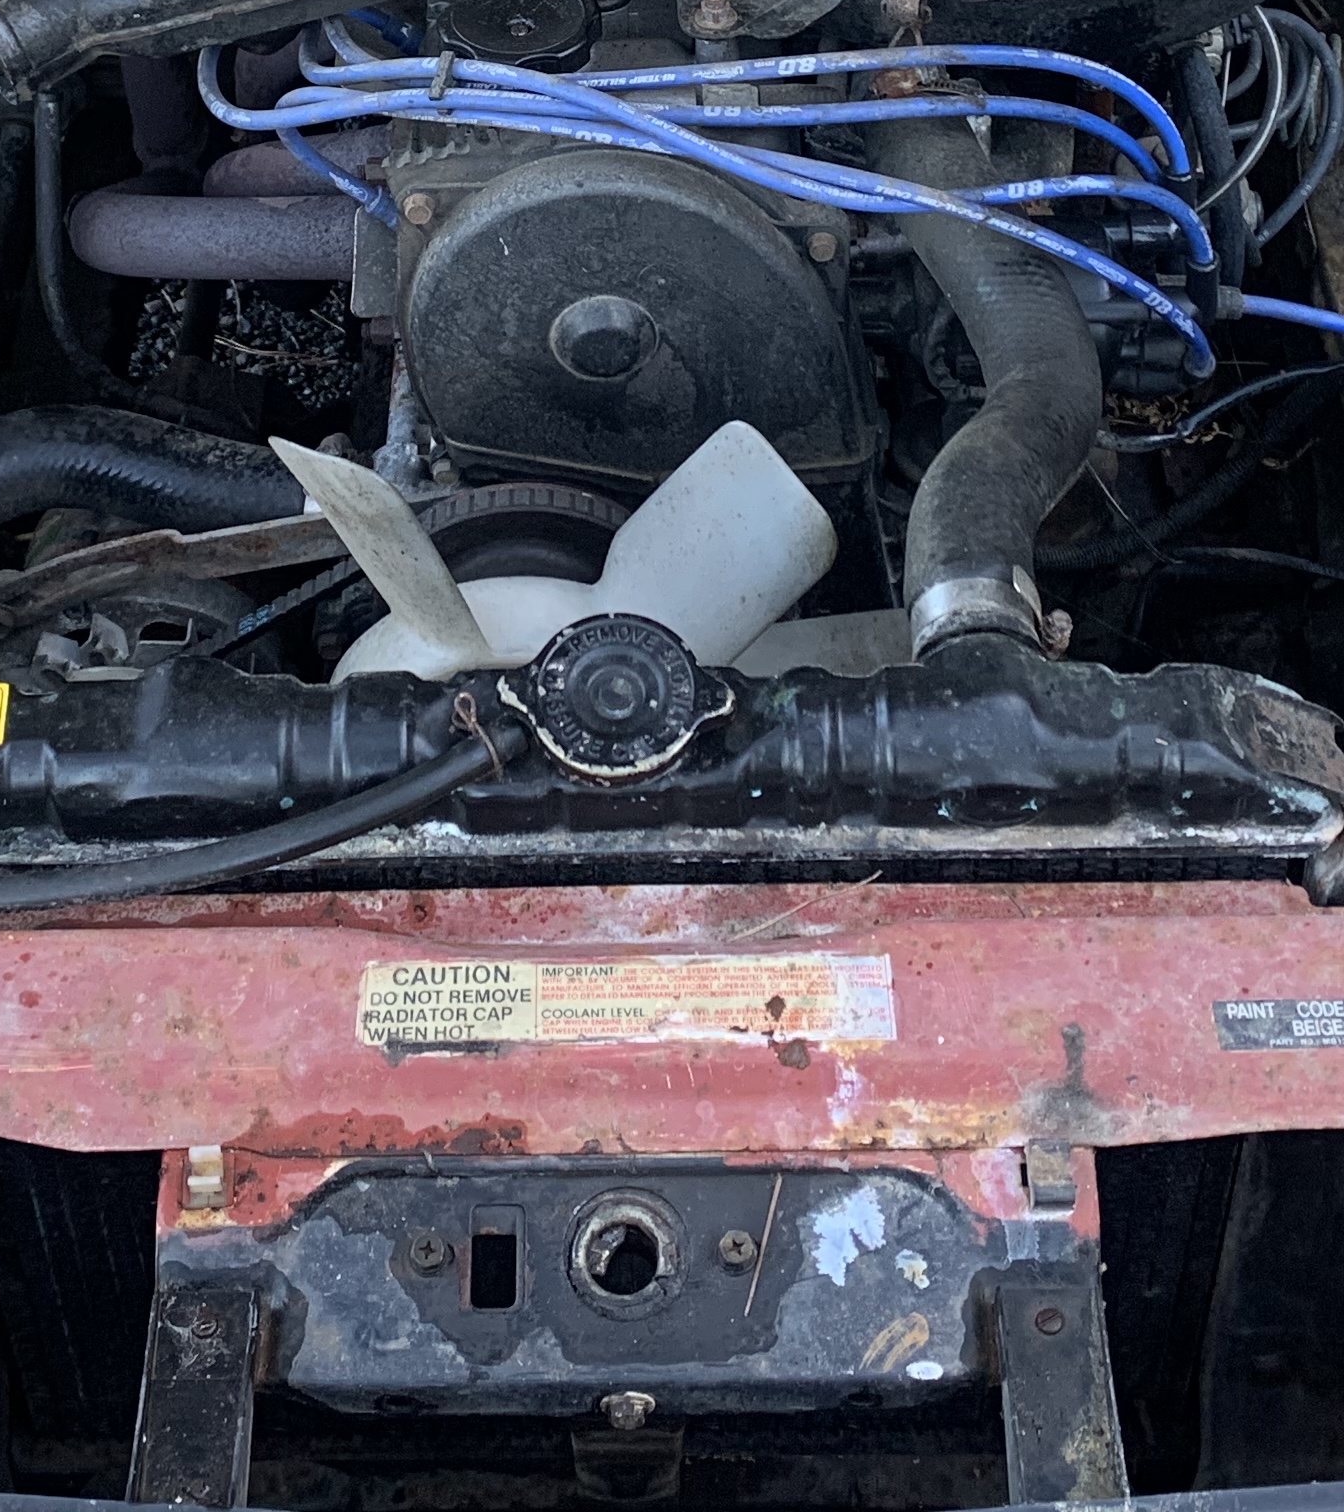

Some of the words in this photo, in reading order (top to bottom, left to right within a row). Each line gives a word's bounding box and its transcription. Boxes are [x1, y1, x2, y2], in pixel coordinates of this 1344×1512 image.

[370, 991, 397, 1006] DO
[403, 990, 443, 1005] NOT
[449, 988, 531, 1004] REMOVE
[369, 1008, 467, 1024] RADIATOR
[474, 1007, 512, 1022] CAP
[542, 1008, 606, 1019] COOLANT
[1226, 1002, 1276, 1019] PAINT
[368, 1026, 428, 1041] WHEN
